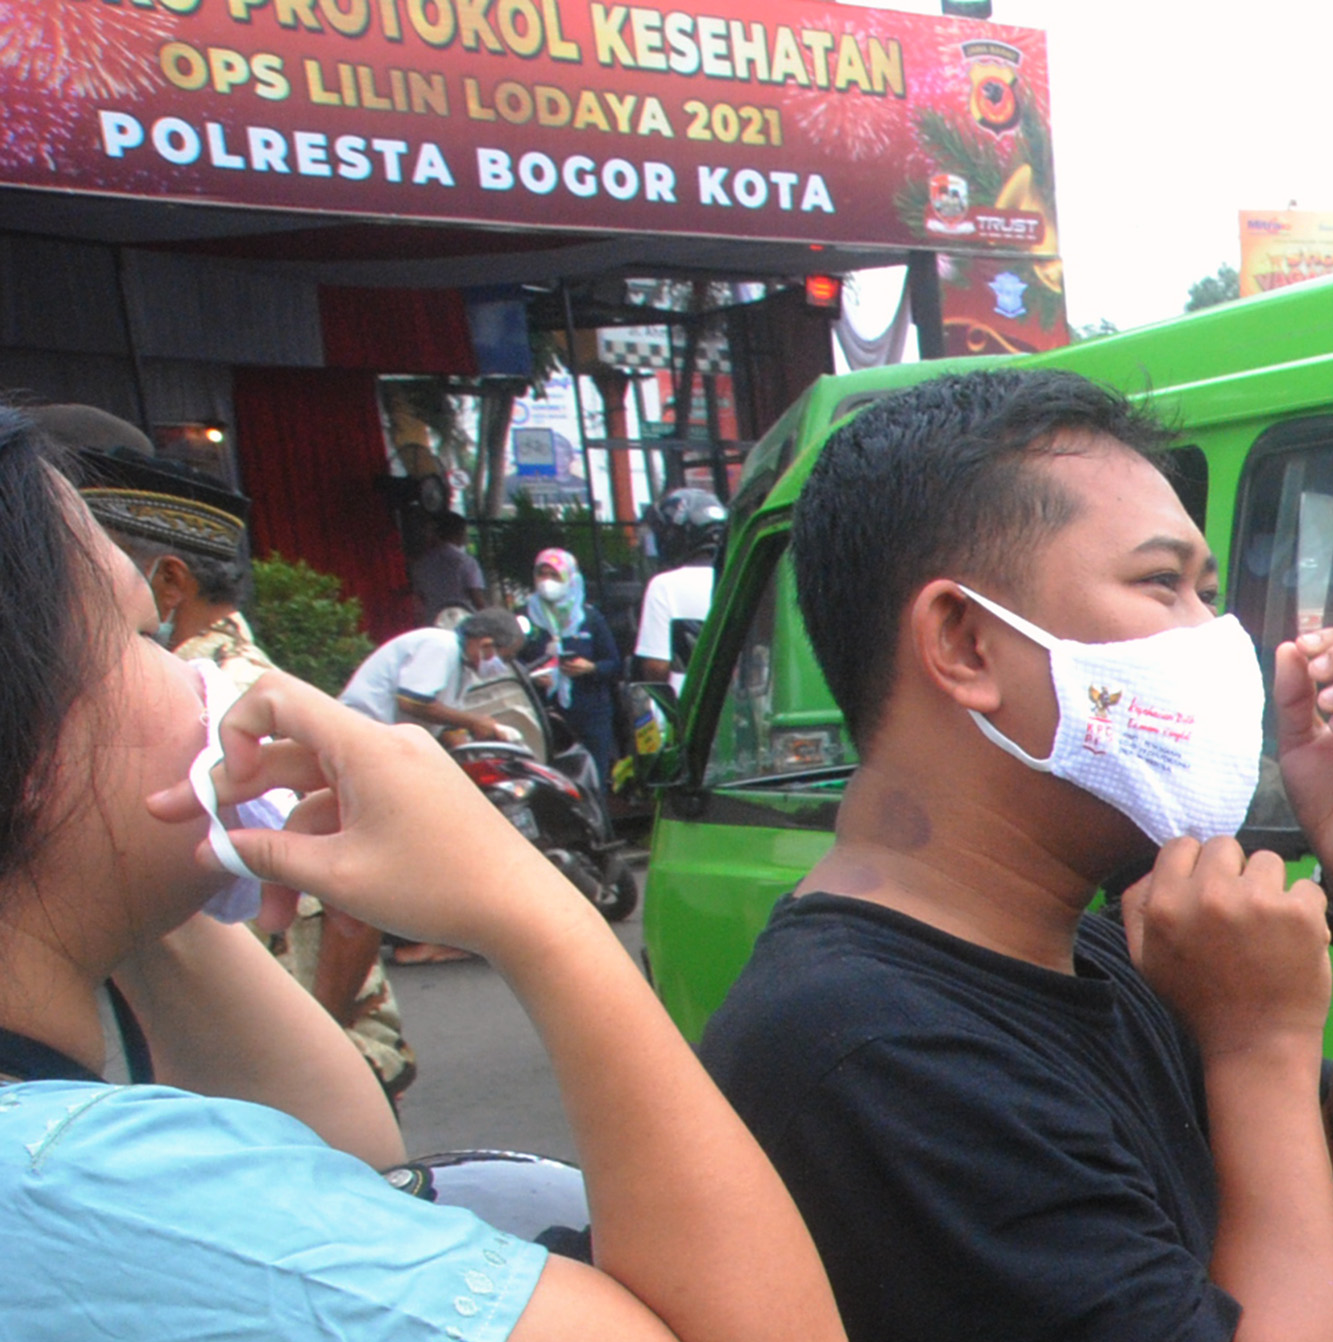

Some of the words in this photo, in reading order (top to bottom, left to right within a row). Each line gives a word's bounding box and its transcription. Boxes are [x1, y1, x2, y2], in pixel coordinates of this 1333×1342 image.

[160, 42, 290, 100] OPS
[304, 59, 448, 117] LILIN
[464, 77, 674, 138] LODAYA
[683, 100, 783, 146] 2021
[590, 2, 905, 96] KESEHATAN
[99, 110, 456, 187] POLRESTA
[476, 148, 677, 203] BOGOR
[698, 165, 836, 213] KOTA
[976, 215, 1039, 234] TRUST
